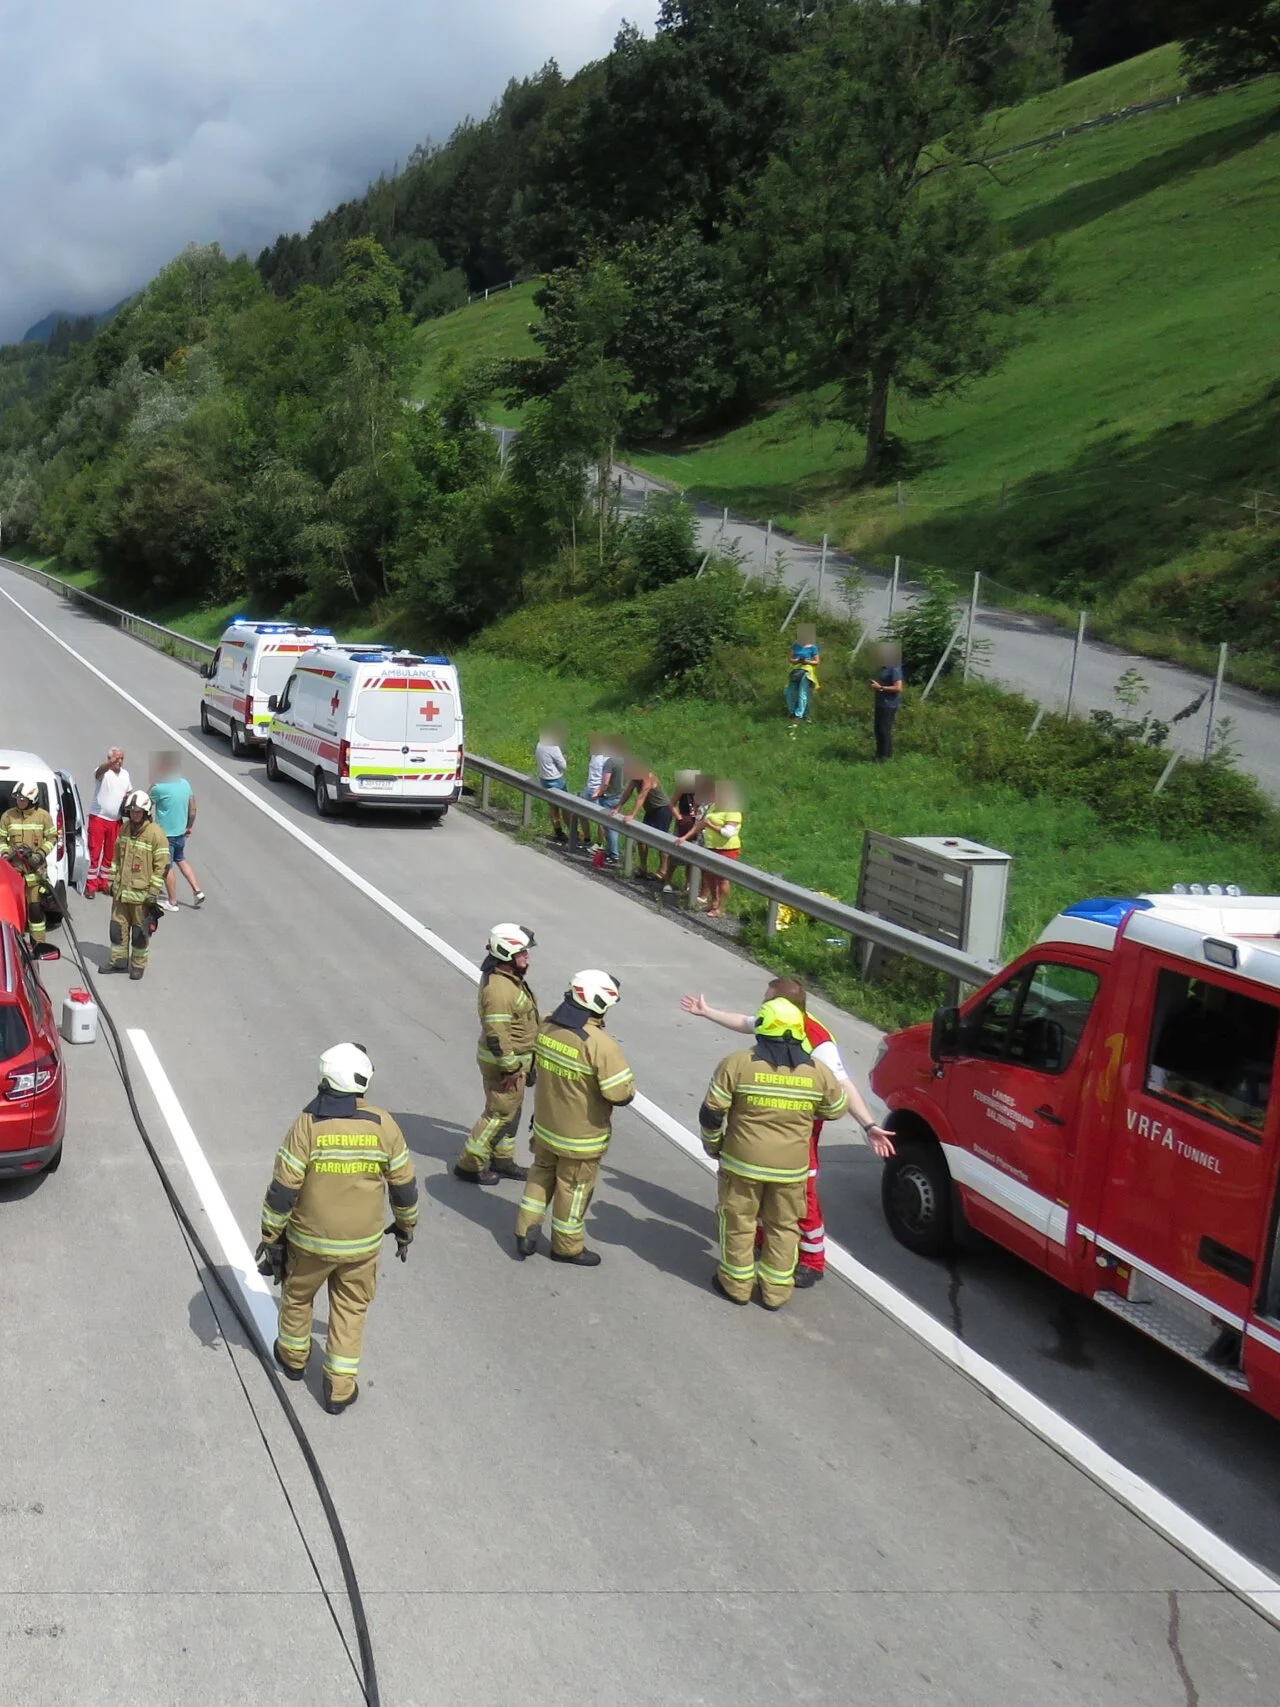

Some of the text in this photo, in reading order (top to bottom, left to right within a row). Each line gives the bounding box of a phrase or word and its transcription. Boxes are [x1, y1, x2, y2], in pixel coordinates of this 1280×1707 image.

[381, 669, 436, 678] AMBULANCE
[754, 1072, 814, 1088] FEUERWEHR
[747, 1095, 814, 1111] PFARRWERFEN
[316, 1134, 378, 1147] FEUERWEHR
[1126, 1108, 1222, 1174] VRFA TUNNEL
